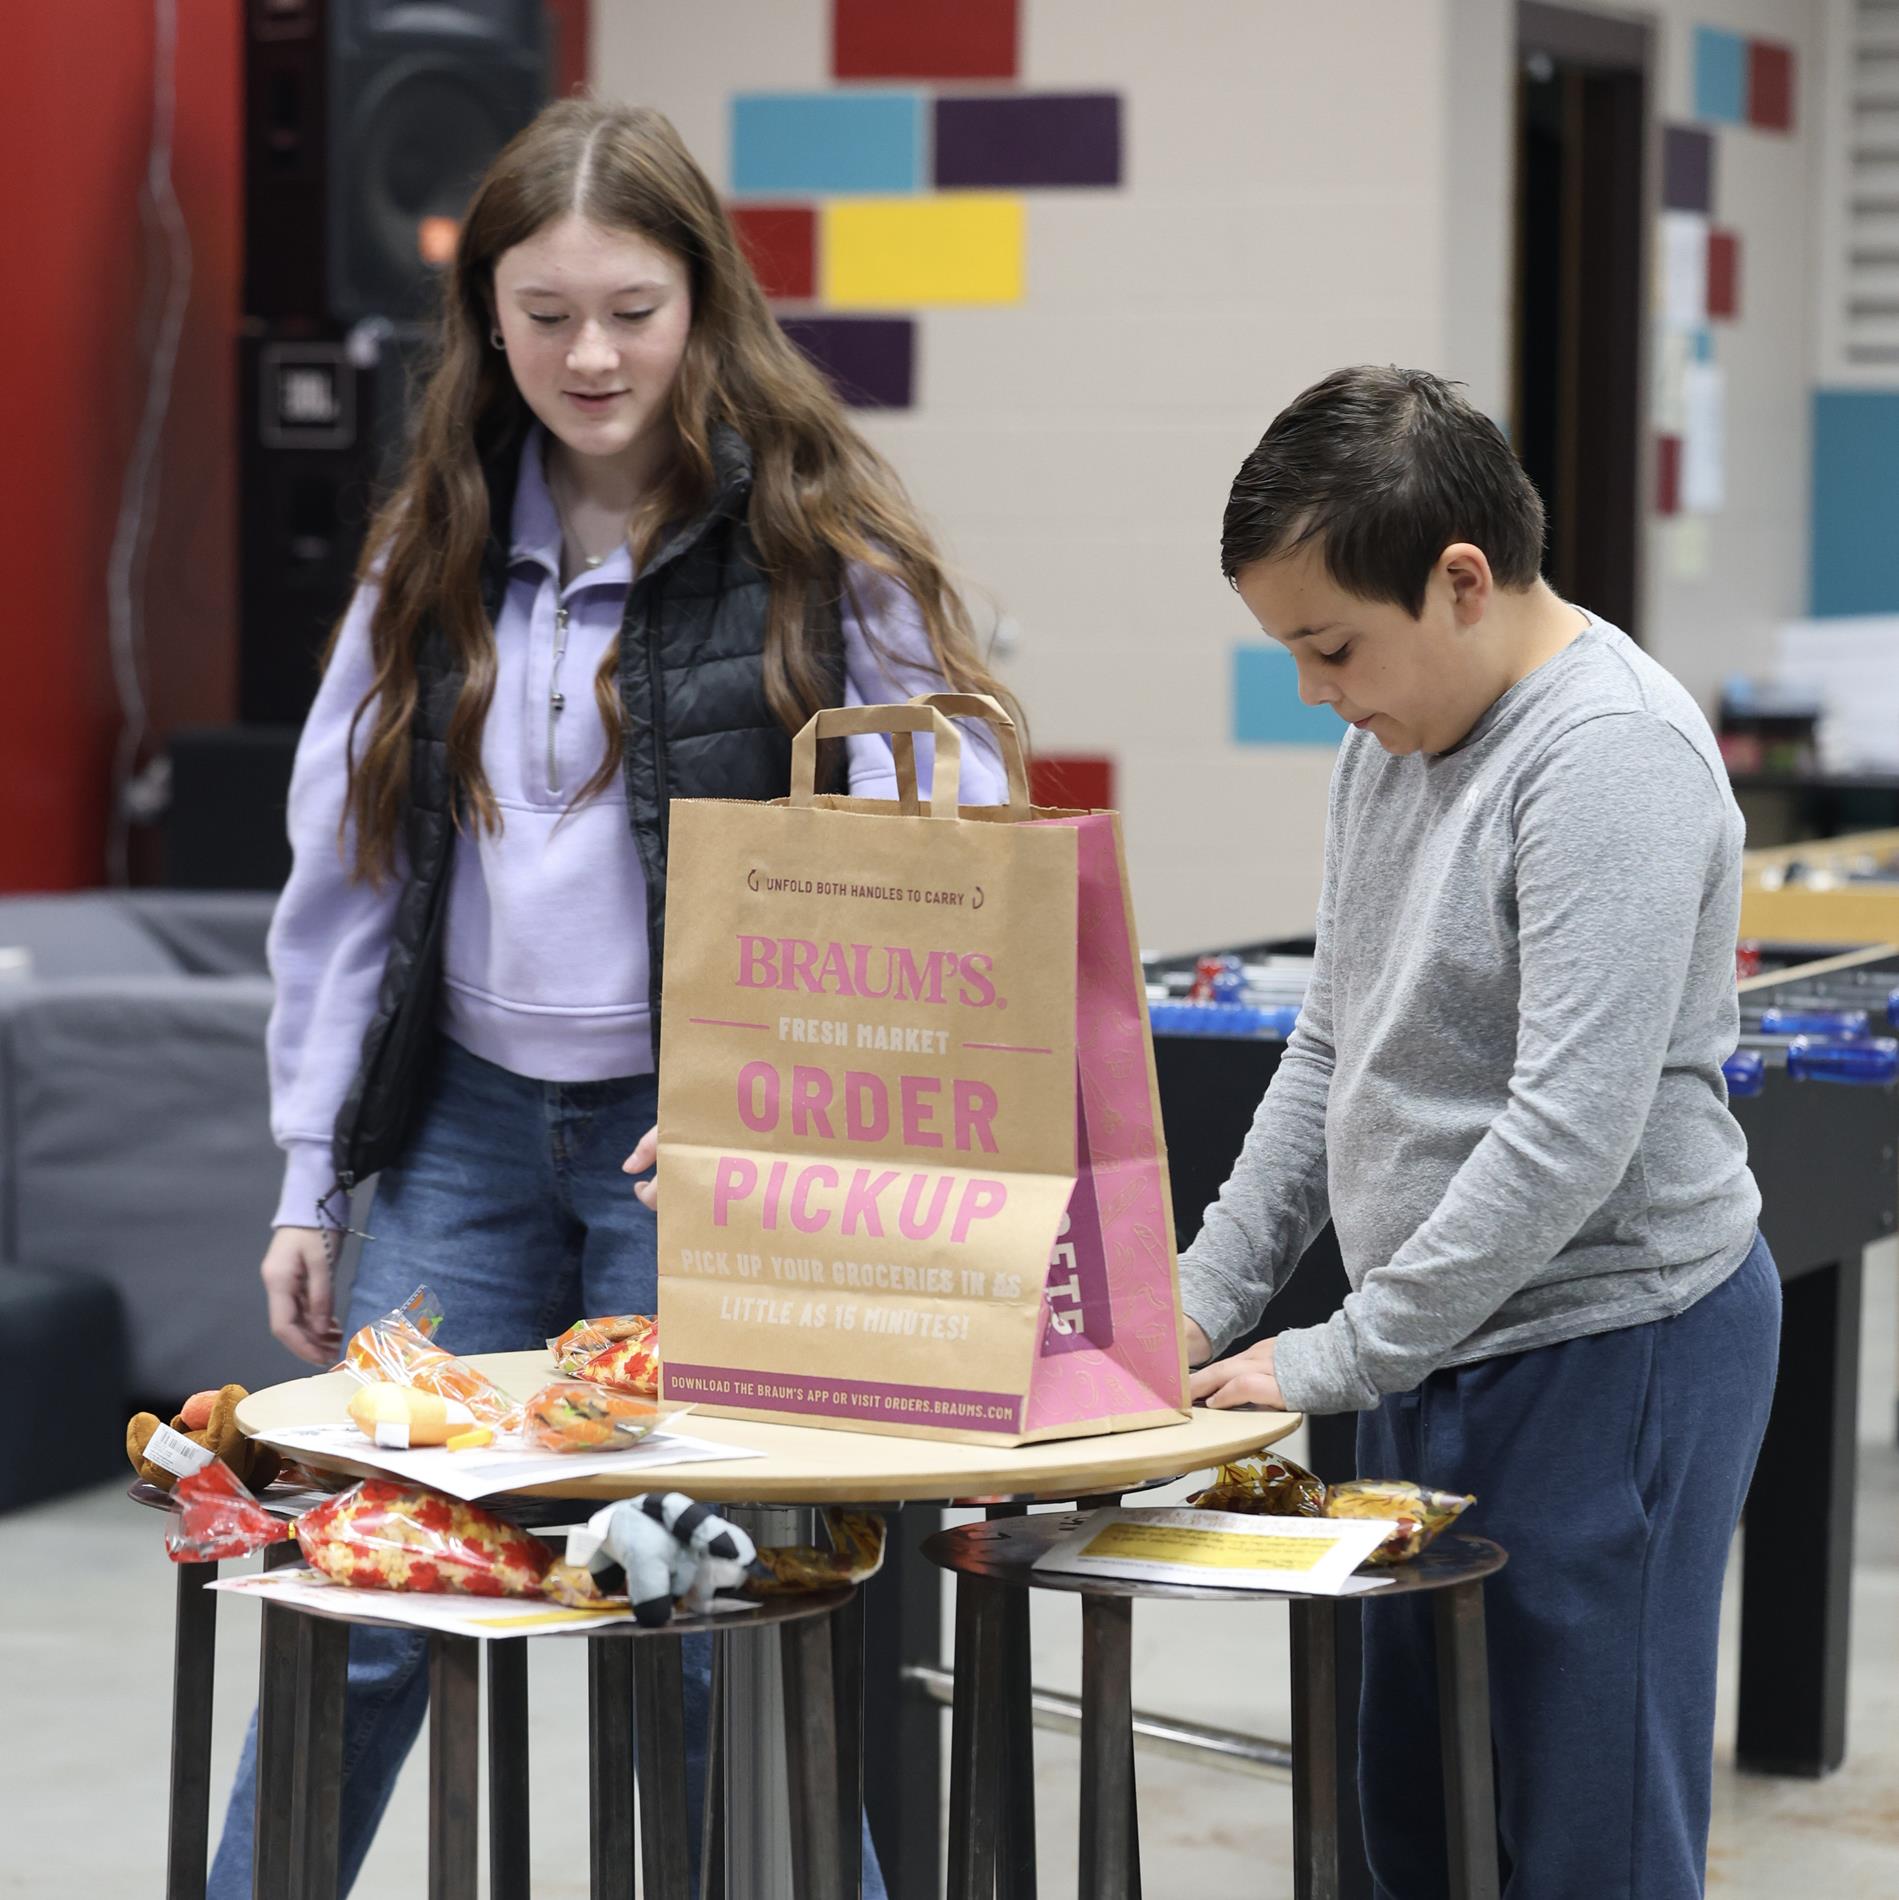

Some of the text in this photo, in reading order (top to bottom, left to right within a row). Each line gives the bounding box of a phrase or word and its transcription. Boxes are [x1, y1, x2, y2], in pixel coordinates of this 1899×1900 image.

[766, 877, 965, 906] UNFOLD BOTH HANDLES TO CARRY
[778, 1016, 949, 1056] FRESH MARKET
[737, 1060, 1000, 1154] ORDER
[713, 1156, 1008, 1244] PICKUP
[681, 1249, 1022, 1299] PICK UP YOUR GROCERIES IN AS
[720, 1296, 970, 1341] LITTLE AS 15 MINUTES!
[671, 1376, 1013, 1421] DOWNLOAD THE BRAUM'S APP OR VISIT ORDERS.BRAUMS.COM
